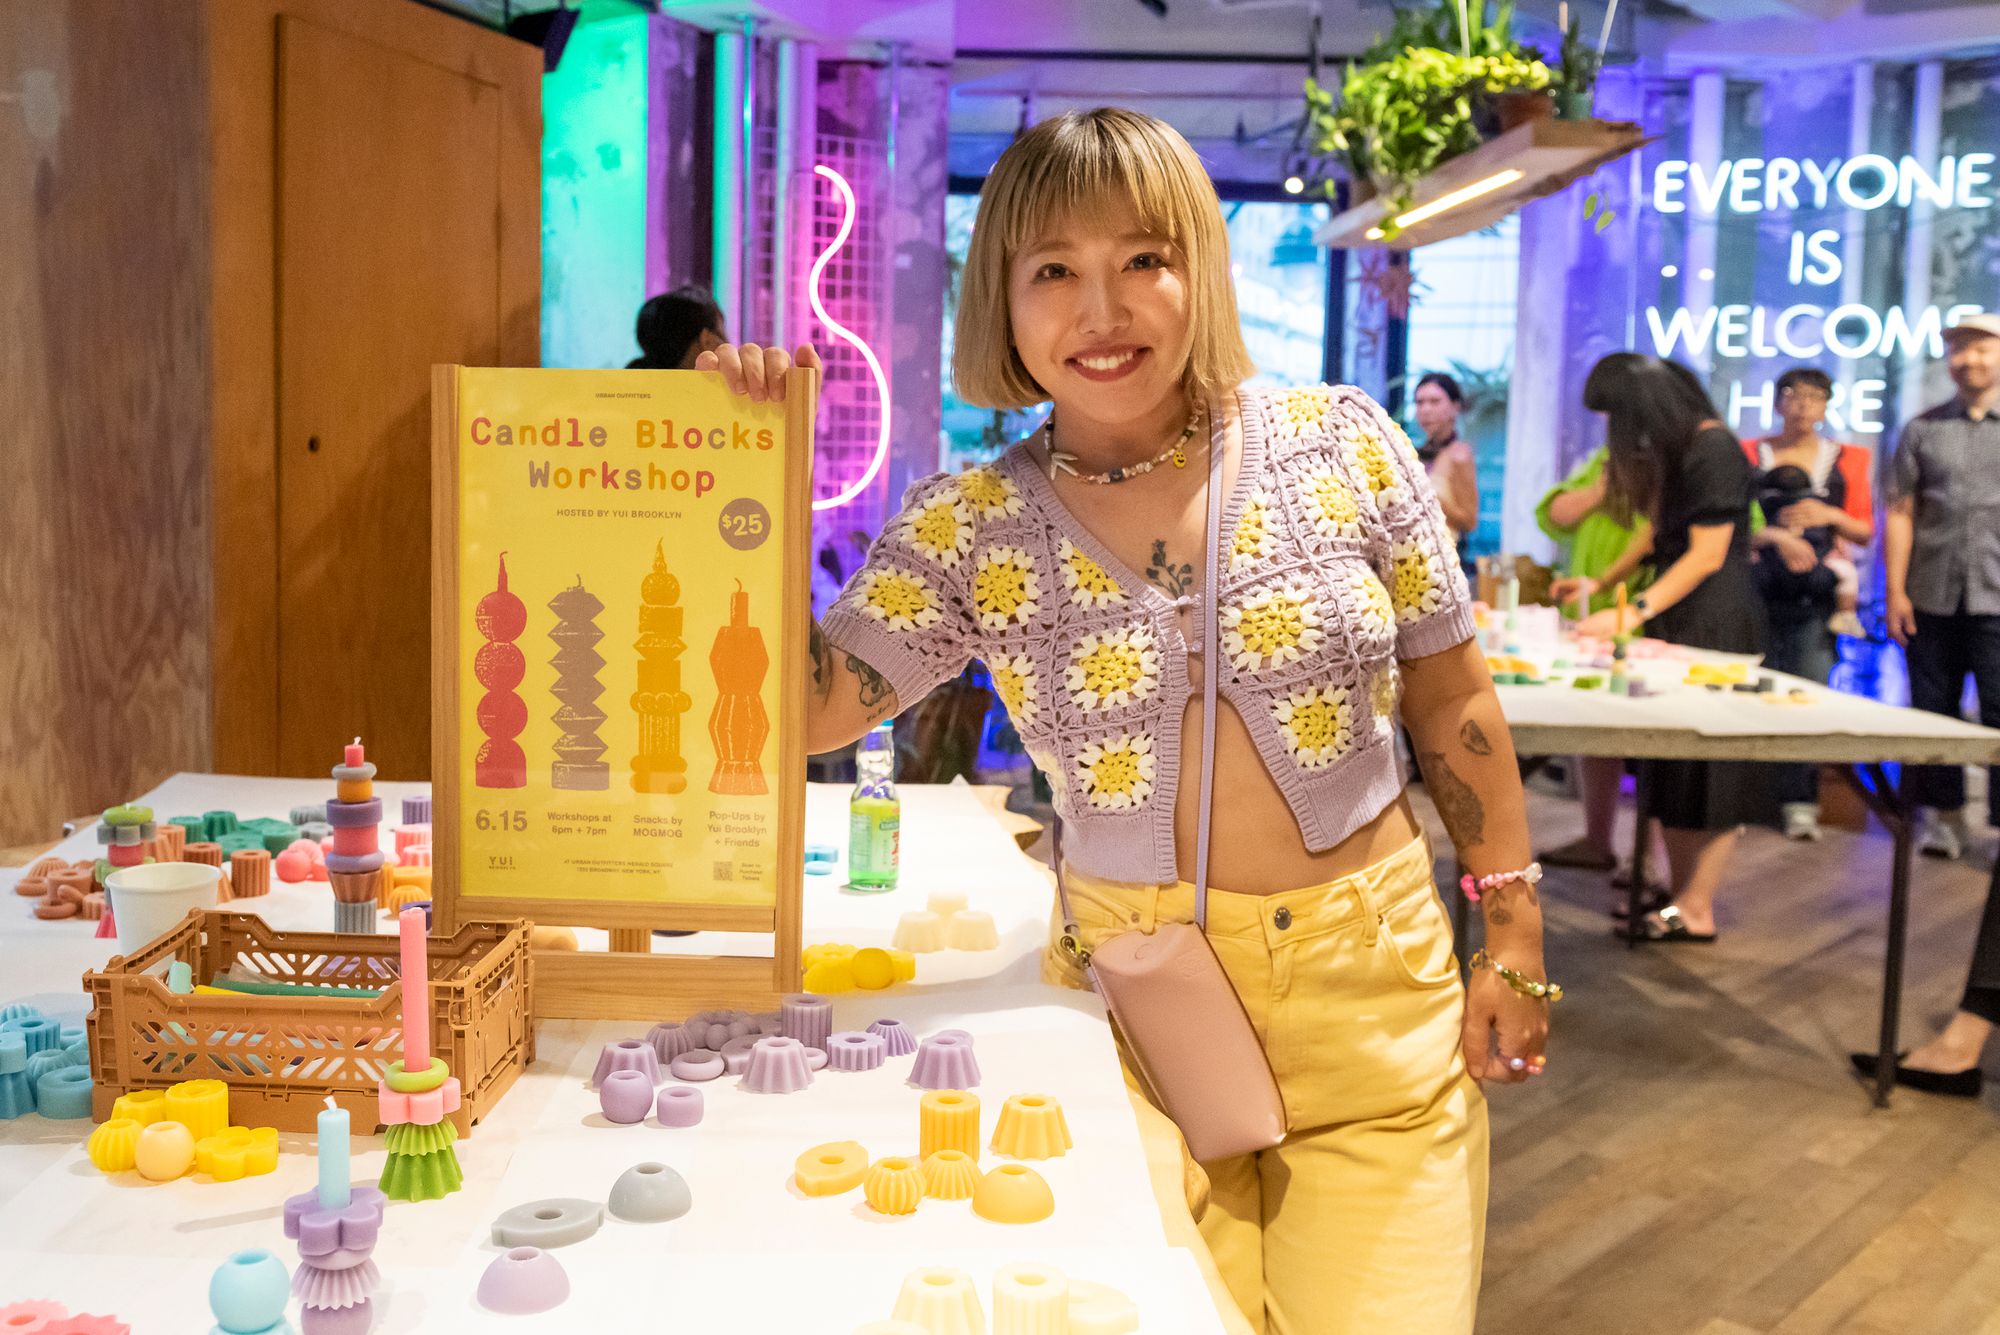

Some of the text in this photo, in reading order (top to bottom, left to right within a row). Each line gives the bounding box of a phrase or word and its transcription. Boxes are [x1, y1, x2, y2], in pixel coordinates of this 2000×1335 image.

[1653, 153, 1995, 213] EVERYONE
[1788, 229, 1842, 286] IS
[1728, 379, 1887, 432] HRE
[470, 416, 775, 451] Candle Blocks
[528, 460, 716, 499] Workshop
[556, 508, 683, 519] HOSTED BY YUI BROOKLYN
[721, 513, 764, 537] $25
[475, 808, 529, 832] 6.15
[547, 811, 613, 823] Workshops at
[633, 814, 683, 827] Snacks by
[709, 810, 766, 823] Pop-Ups by
[551, 825, 608, 837] 6pm + 7pm
[633, 827, 683, 839] MOGMOG
[706, 823, 767, 836] Yui Brooklyn
[724, 836, 761, 848] Friends
